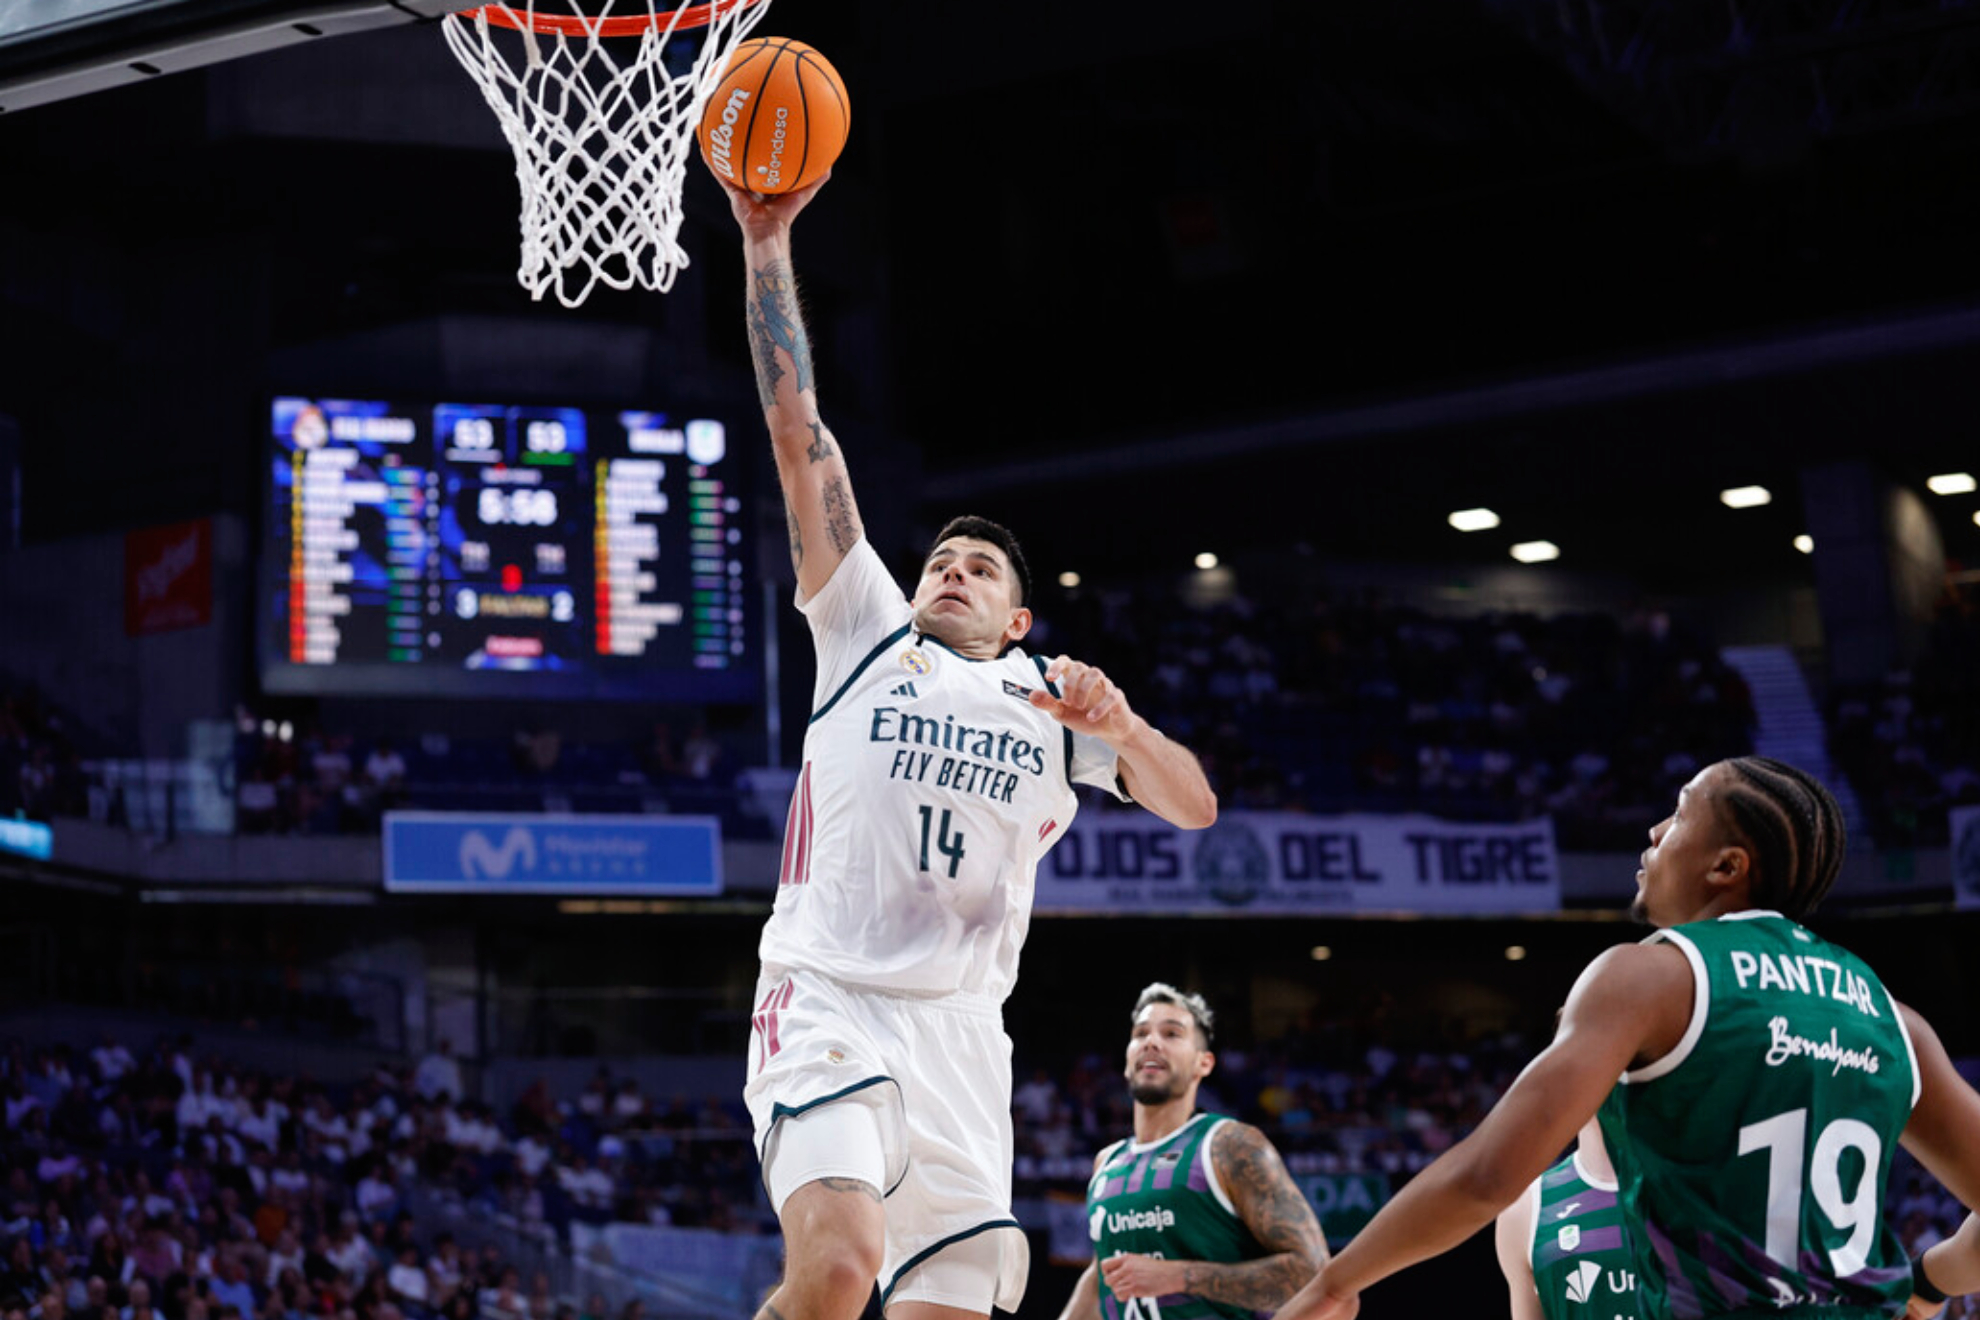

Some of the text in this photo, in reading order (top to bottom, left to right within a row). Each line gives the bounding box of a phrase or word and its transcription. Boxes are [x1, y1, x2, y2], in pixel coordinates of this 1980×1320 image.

[711, 88, 751, 179] Wilson
[870, 707, 1045, 776] Emirates
[890, 749, 1018, 804] FLY BETTER
[918, 805, 965, 878] 14
[1054, 828, 1550, 884] OJOS DEL TIGRE
[1730, 950, 1881, 1019] PANTZAR
[1107, 1205, 1174, 1233] Unicaja
[1738, 1107, 1882, 1278] 19
